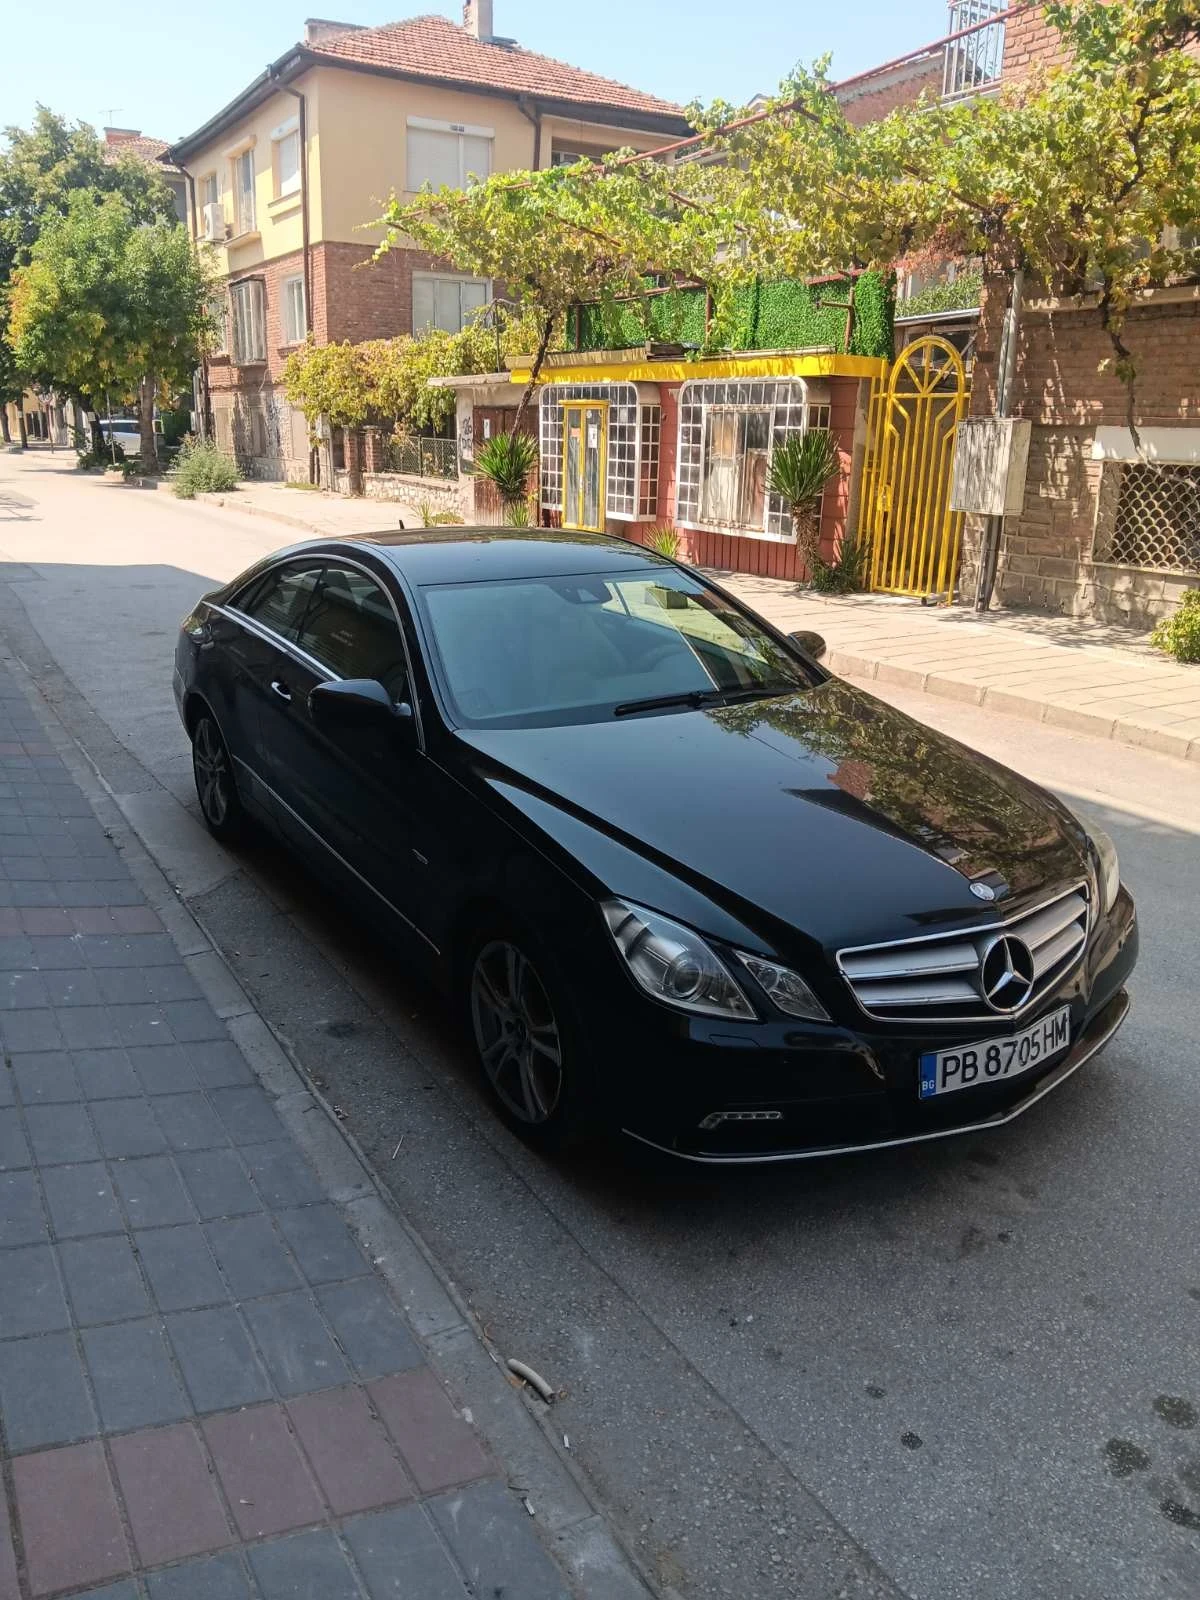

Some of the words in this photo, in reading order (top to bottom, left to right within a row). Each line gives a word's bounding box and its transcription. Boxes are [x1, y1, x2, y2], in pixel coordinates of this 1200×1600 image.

[941, 1051, 979, 1089] PB
[984, 1029, 1041, 1077] 8705
[1042, 1013, 1067, 1054] HM
[921, 1080, 935, 1091] BG
